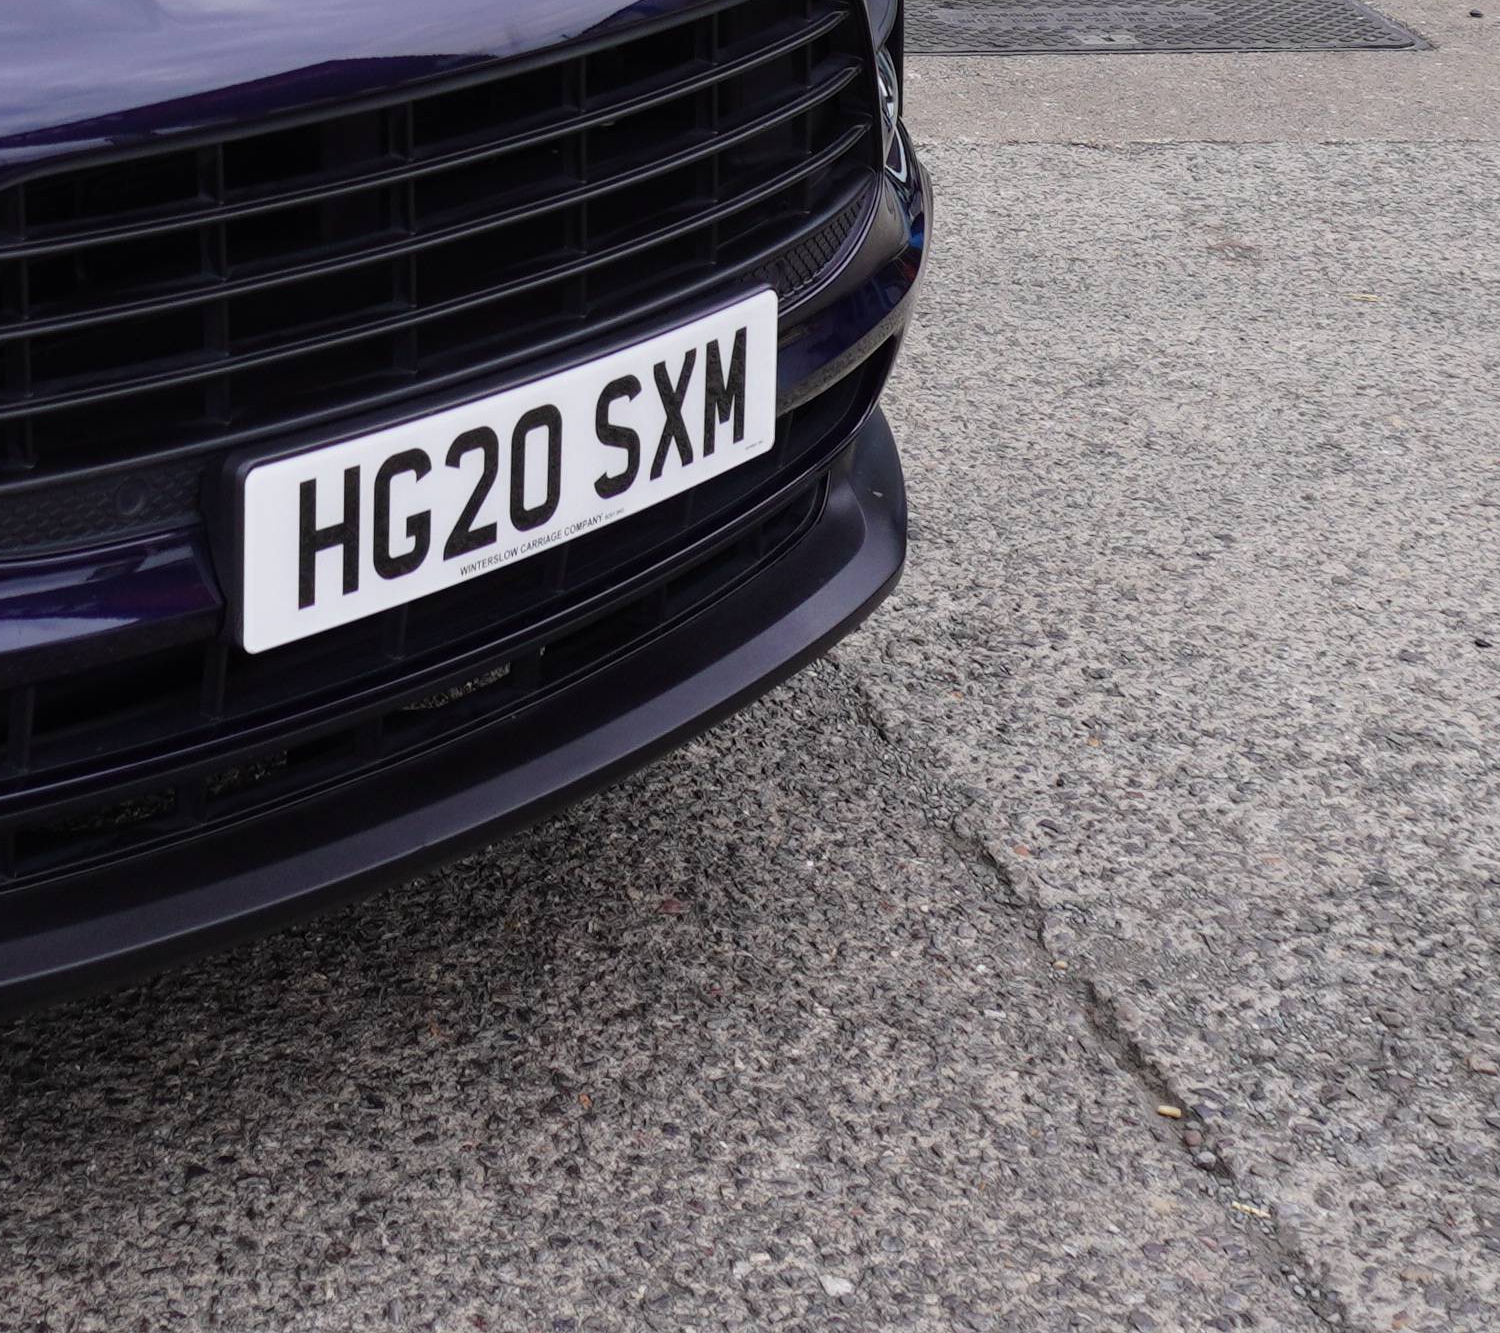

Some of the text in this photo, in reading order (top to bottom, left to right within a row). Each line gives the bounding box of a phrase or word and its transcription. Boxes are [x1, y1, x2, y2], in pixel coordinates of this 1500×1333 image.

[297, 326, 748, 612] HG20 SXM
[460, 546, 519, 576] WINTERSLOW
[520, 529, 563, 554] CARRIAGE
[564, 512, 604, 537] COMPANY
